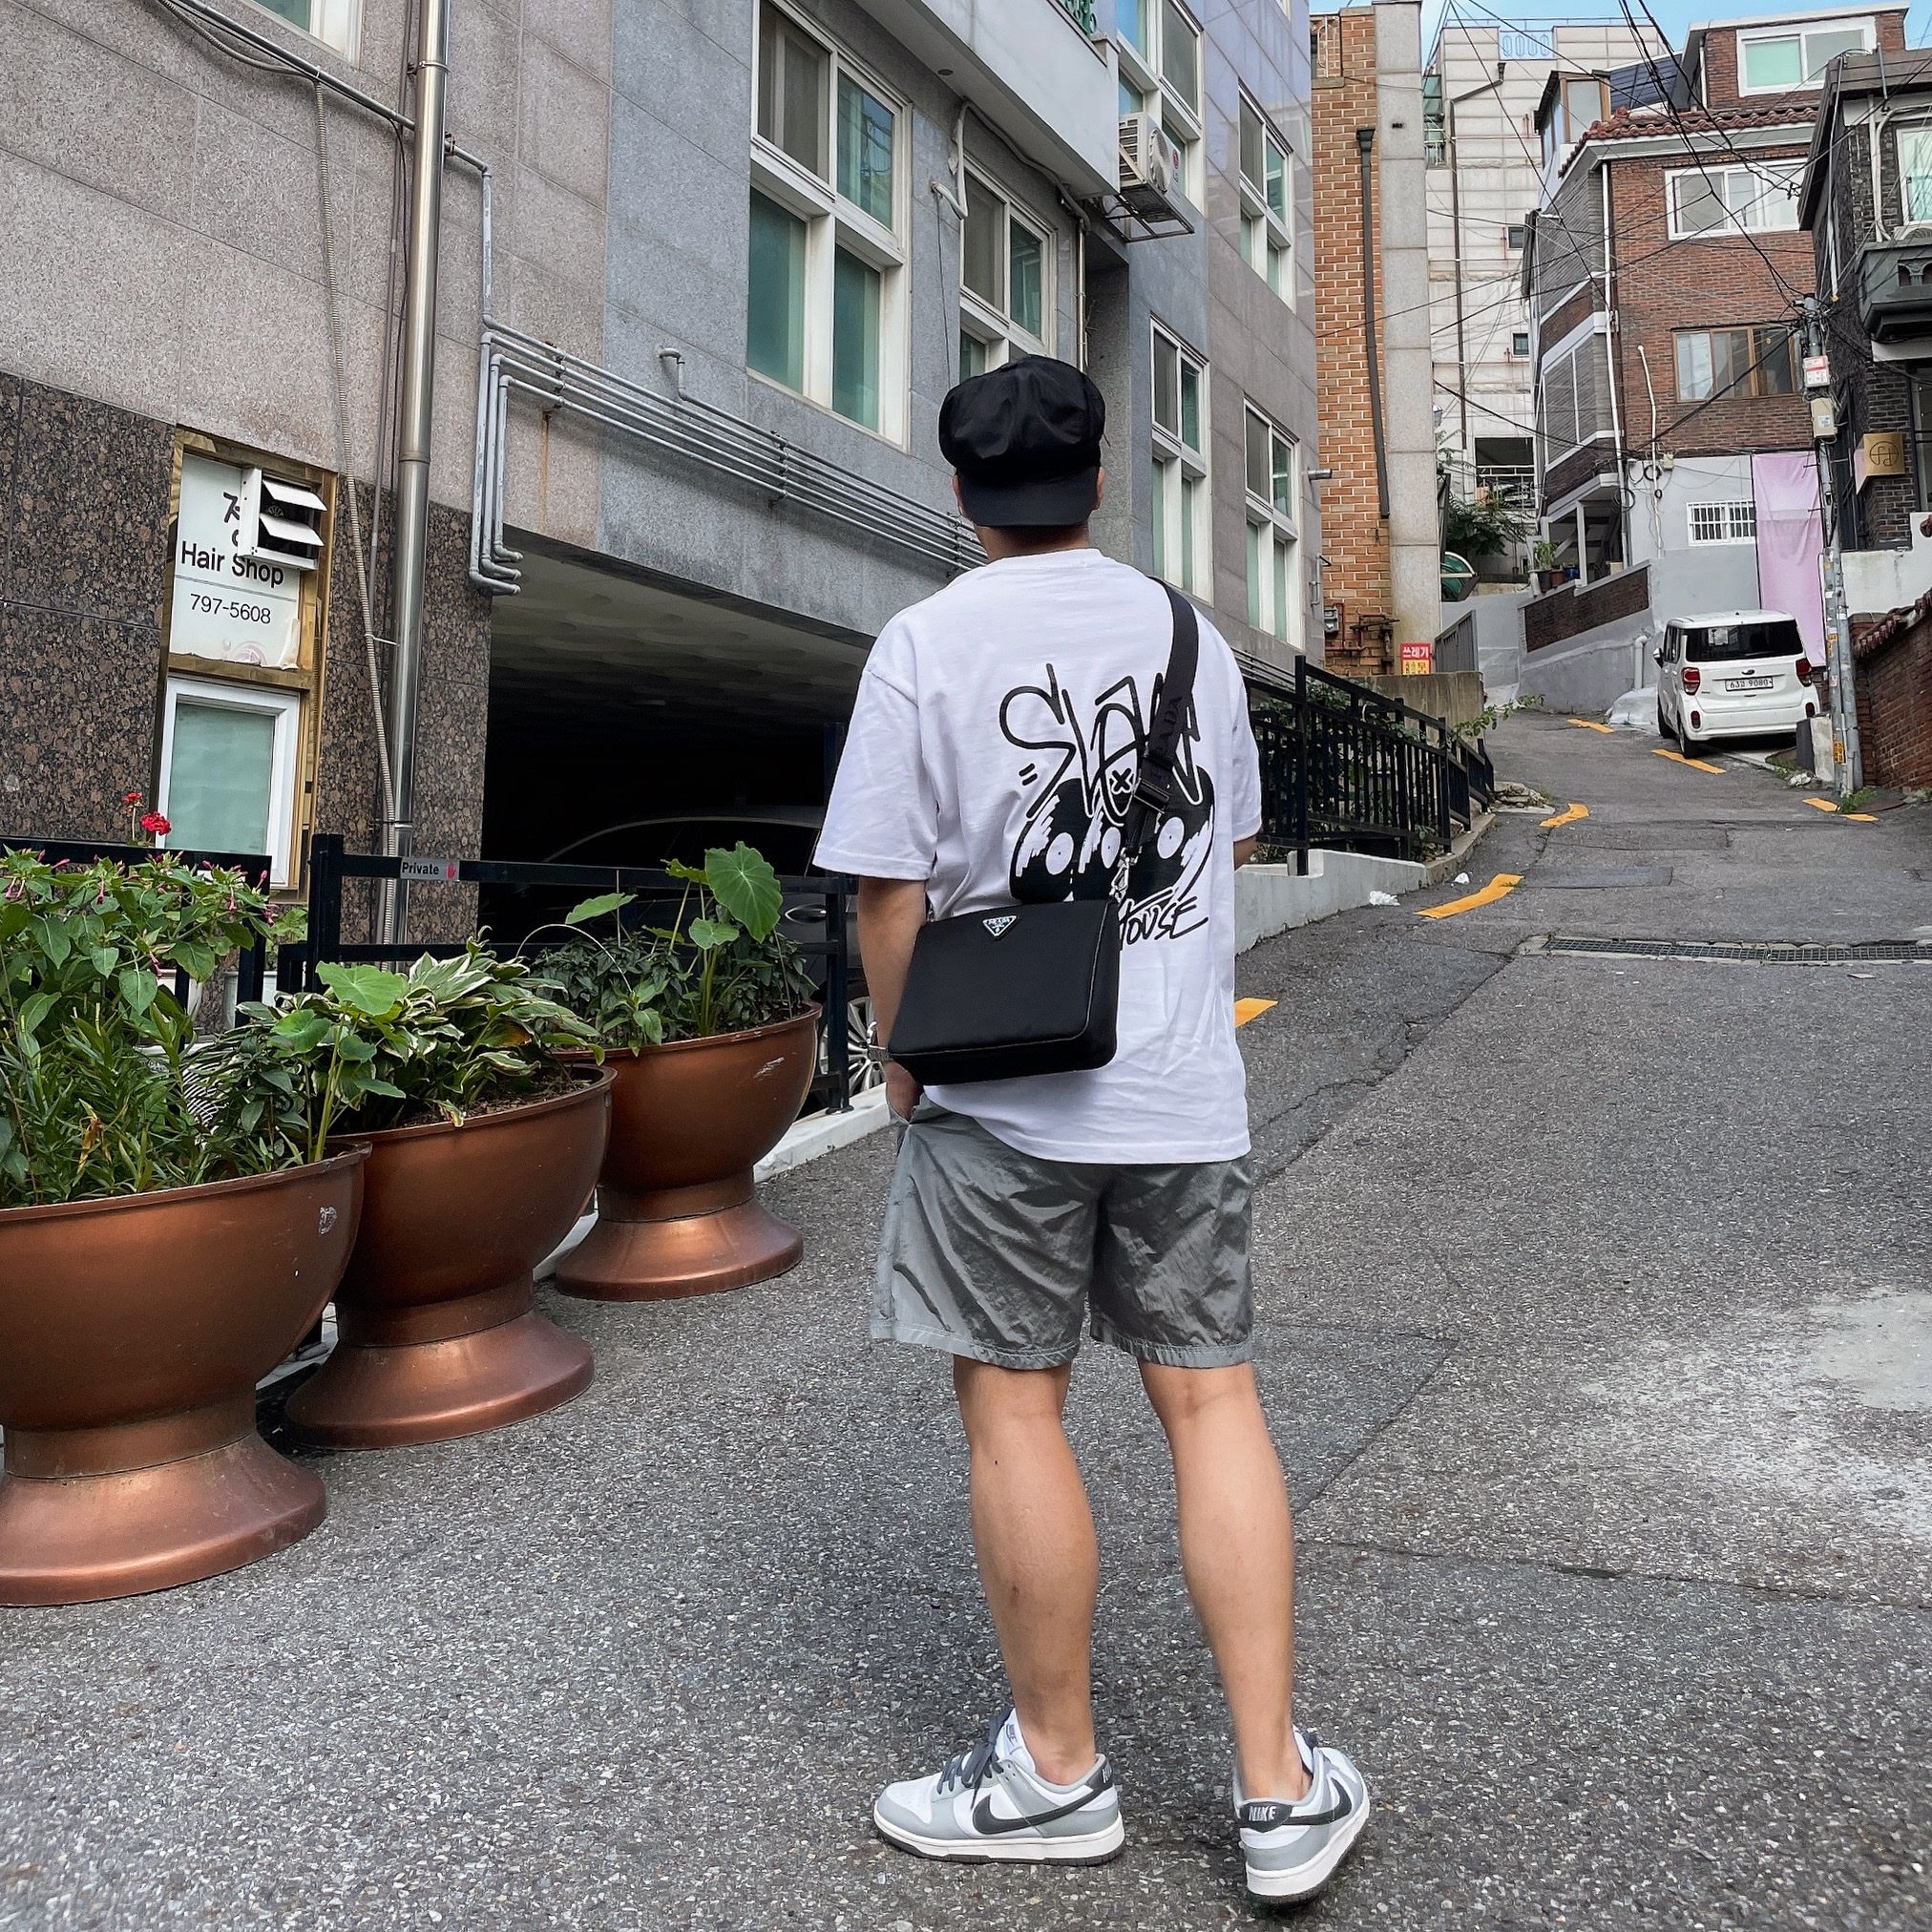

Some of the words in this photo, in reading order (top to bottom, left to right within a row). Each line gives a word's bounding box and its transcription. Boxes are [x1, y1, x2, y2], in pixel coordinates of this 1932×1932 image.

[181, 540, 225, 572] Hair
[231, 552, 284, 588] Shop
[190, 593, 272, 624] 797-5608
[1402, 646, 1429, 659] 쓰레기
[401, 862, 440, 875] Private
[1249, 1805, 1277, 1821] NIKE
